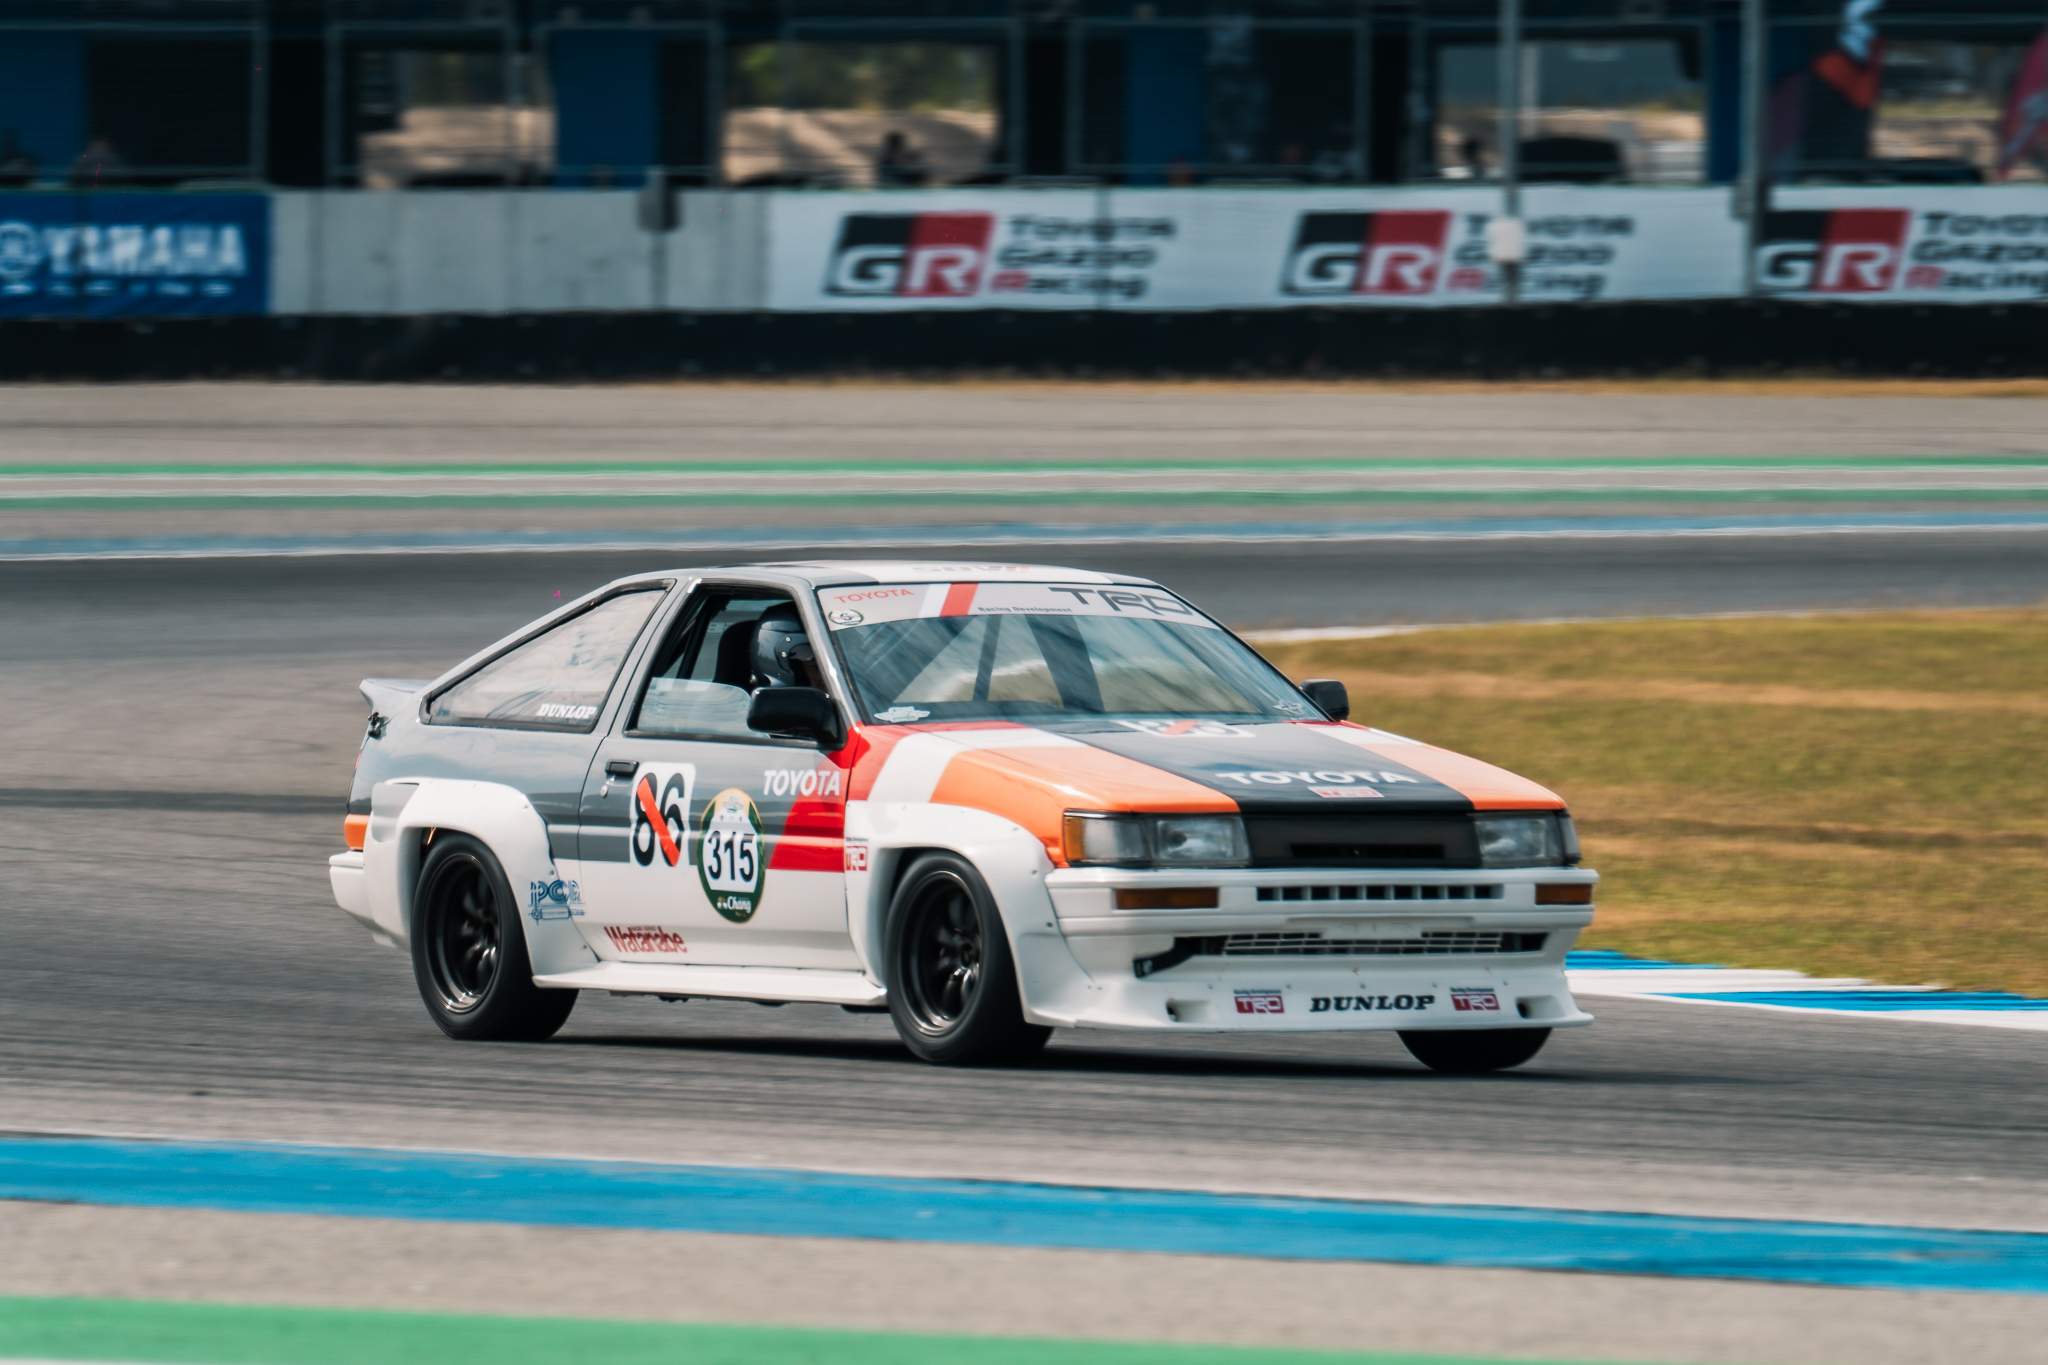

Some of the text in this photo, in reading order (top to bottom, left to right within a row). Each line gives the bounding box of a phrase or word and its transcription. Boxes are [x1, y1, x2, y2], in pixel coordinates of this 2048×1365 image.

[43, 223, 247, 277] YAMAHA
[836, 245, 980, 292] GR
[1292, 242, 1436, 289] GR
[1756, 242, 1891, 287] GR
[833, 589, 915, 604] TOYOTA
[1047, 587, 1193, 616] TRD
[536, 703, 598, 719] DUNLOP
[763, 769, 841, 796] TOYOTA
[1216, 770, 1419, 785] TOYOTA
[632, 772, 684, 867] 86
[707, 830, 756, 882] 315
[727, 895, 752, 914] Chang
[603, 925, 688, 953] Watanabe
[1236, 995, 1283, 1013] TRD
[1309, 995, 1436, 1012] DUNLOP
[1452, 993, 1499, 1010] TRD
